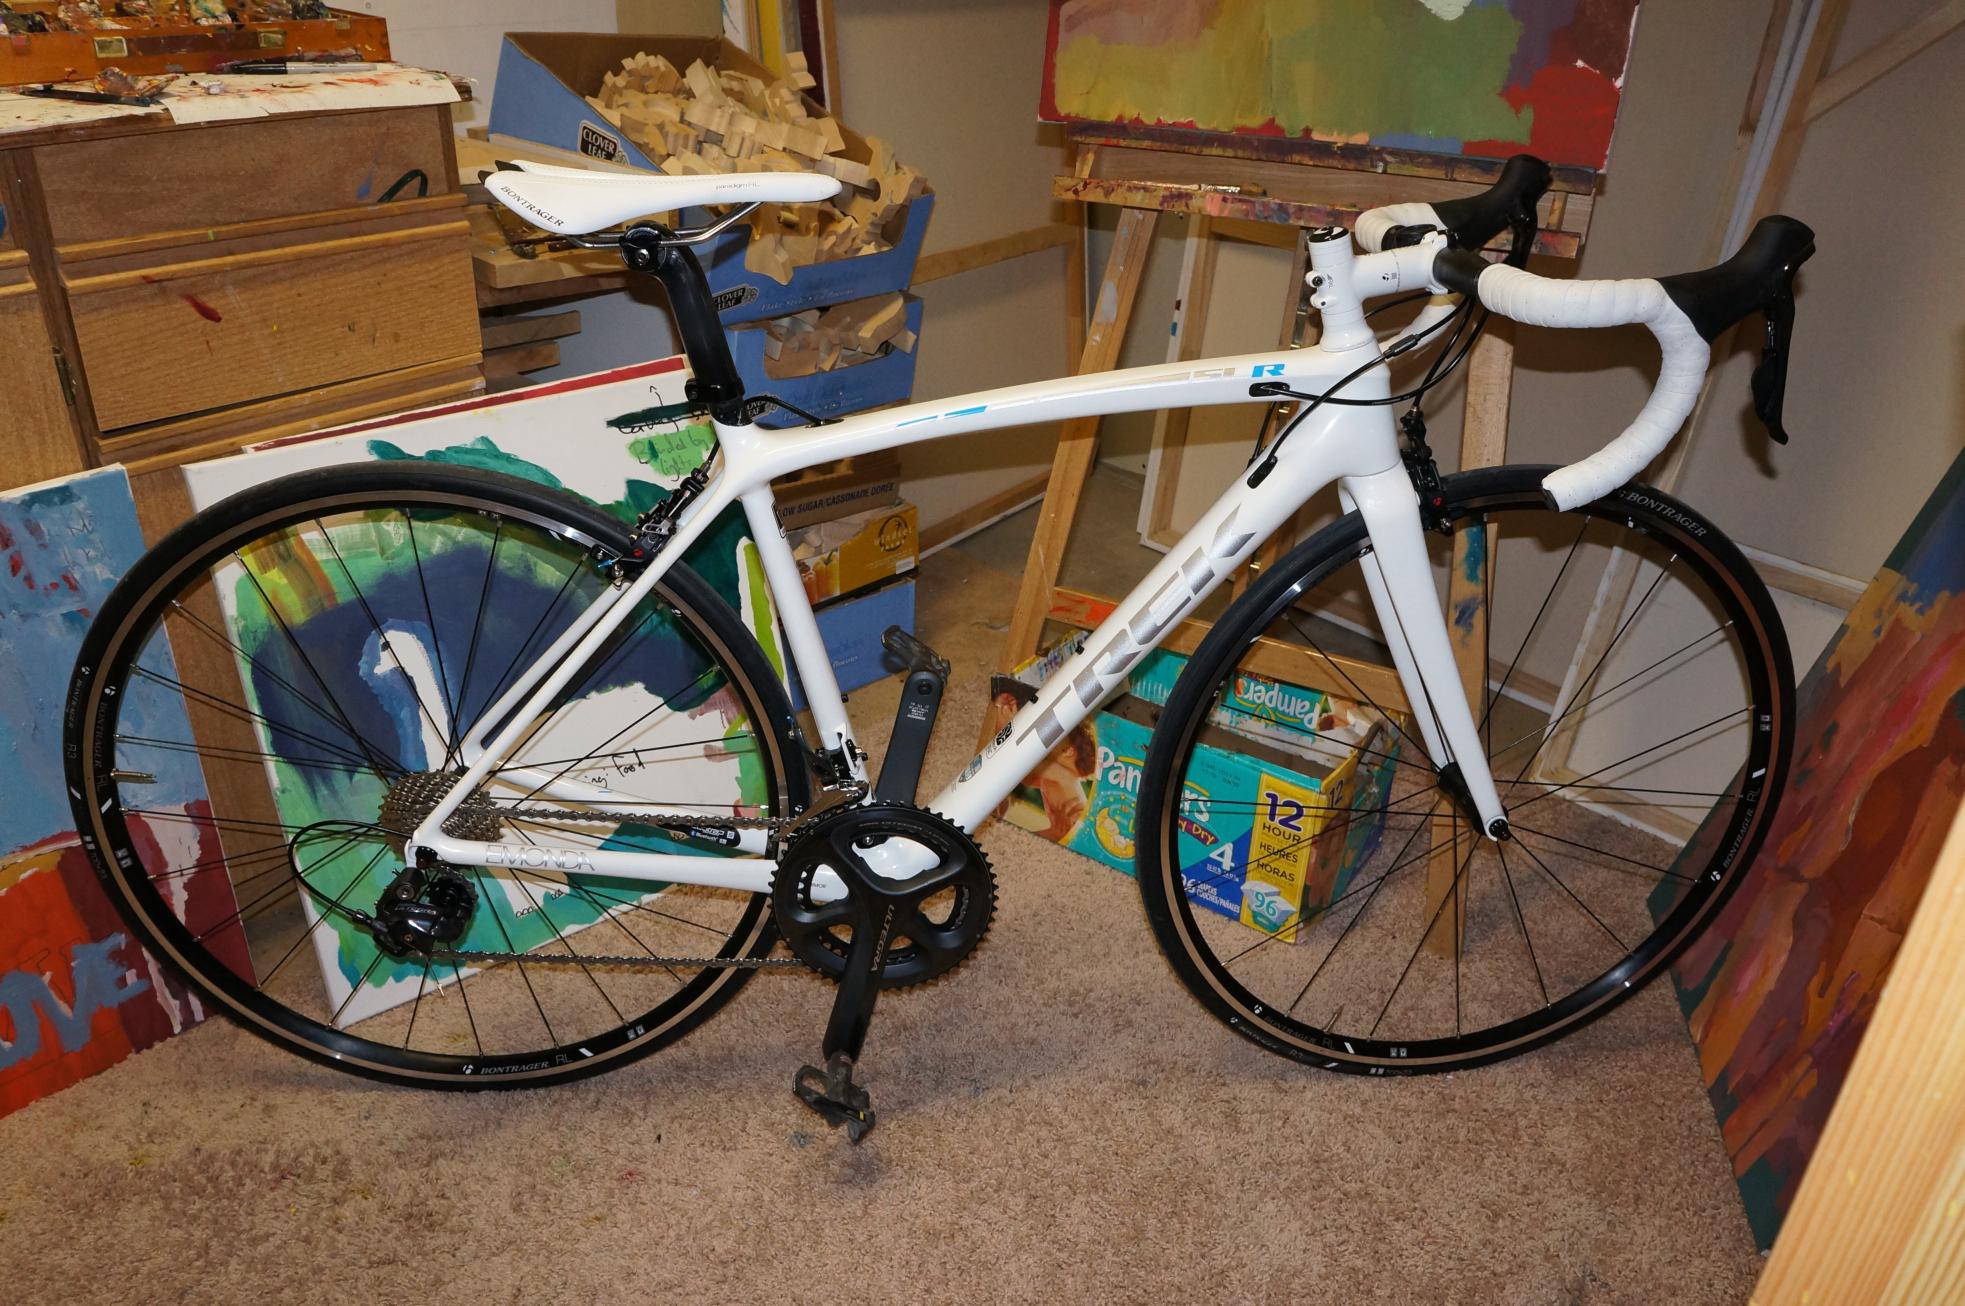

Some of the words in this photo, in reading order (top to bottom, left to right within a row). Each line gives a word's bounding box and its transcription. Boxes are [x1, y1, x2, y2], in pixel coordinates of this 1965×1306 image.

[582, 129, 615, 154] CLOVER
[500, 185, 565, 227] BONTRAGER
[1626, 491, 1708, 537] BONTRAGER
[1015, 503, 1257, 749] TREK
[1265, 791, 1305, 832] 12
[1191, 824, 1215, 846] Dry
[1262, 822, 1302, 843] HOUR
[1722, 807, 1755, 870] BONTRAGER
[1208, 842, 1235, 872] 4
[1259, 841, 1299, 864] HEURES
[1256, 860, 1296, 882] HORAS
[1254, 891, 1278, 918] 96
[871, 904, 895, 972] ULTEGRA
[480, 1060, 549, 1075] BONTRAGER
[555, 1053, 574, 1065] RL
